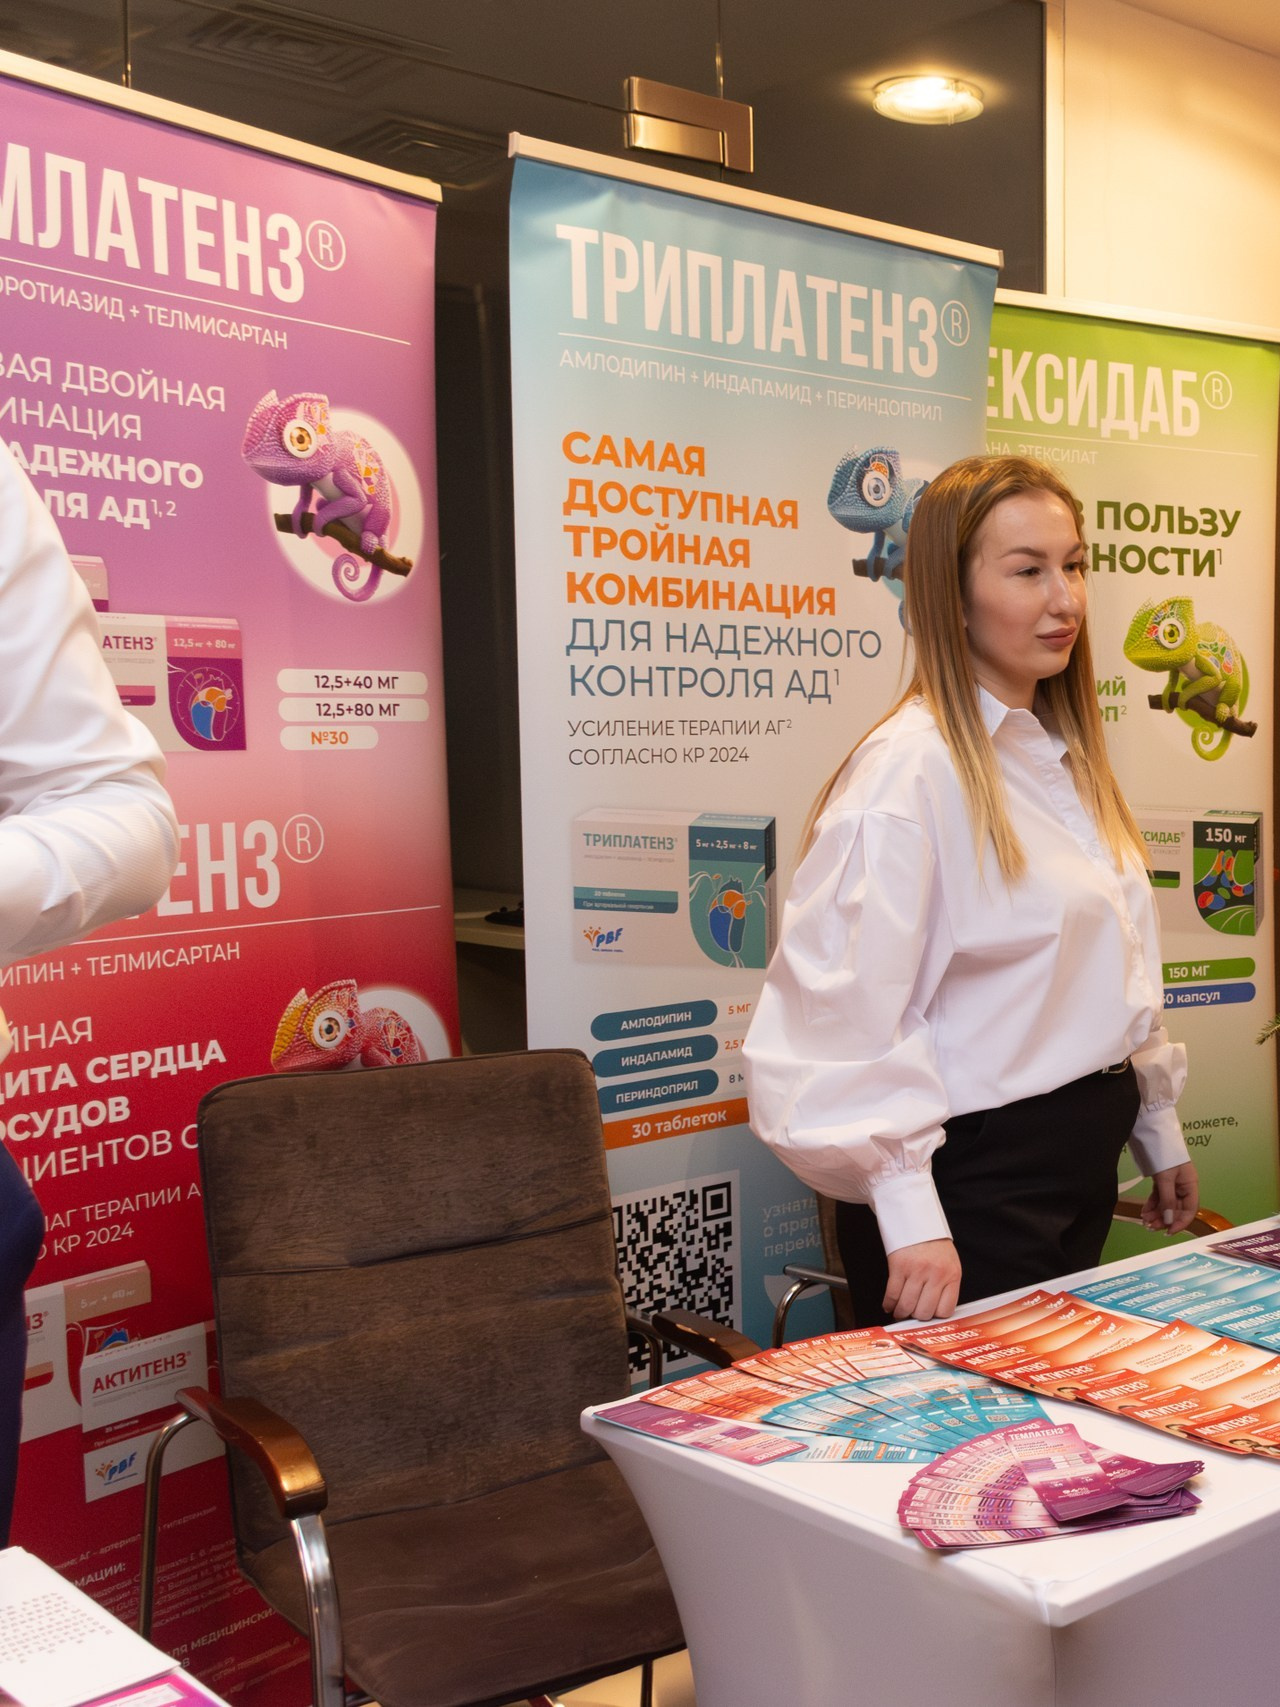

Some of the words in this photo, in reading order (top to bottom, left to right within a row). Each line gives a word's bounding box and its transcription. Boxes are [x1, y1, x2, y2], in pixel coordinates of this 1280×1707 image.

[0, 275, 125, 322] РОТИАЗИД
[129, 305, 140, 317] +
[147, 304, 288, 351] ТЕЛМИСАРТАН
[0, 352, 52, 385] АЯ
[62, 362, 225, 412] ДВОЙНАЯ
[559, 348, 686, 384] АМЛОДИПИН
[690, 372, 699, 383] +
[703, 369, 812, 406] ИНДАПАМИД
[826, 389, 942, 422] ПЕРИНДОПРИЛ
[561, 431, 706, 477] САМАЯ
[1018, 443, 1098, 465] ЭТЕКСИЛАТ
[562, 478, 799, 530] ДОСТУПНАЯ
[1097, 500, 1241, 538] ПОЛЬЗУ
[562, 522, 750, 568] ТРОЙНАЯ
[566, 571, 836, 619] КОМБИНАЦИЯ
[174, 638, 194, 650] 12,5
[566, 618, 652, 657] ДЛЯ
[666, 622, 882, 660] НАДЕЖНОГО
[314, 674, 372, 692] 12,5+40
[378, 676, 399, 690] МГ
[569, 665, 773, 699] КОНТРОЛЯ
[315, 703, 374, 719] 12,5+80
[379, 704, 400, 717] МГ
[311, 730, 349, 746] №30
[567, 720, 675, 737] УСИЛЕНИЕ
[678, 719, 761, 736] ТЕРАПИИ
[568, 748, 678, 766] СОГЛАСНО
[683, 747, 705, 763] КР
[709, 746, 750, 762] 2024
[583, 833, 675, 851] ТРИПЛАТЕНЗ
[1140, 831, 1180, 844] СИДАБ
[1205, 828, 1232, 843] 150
[1235, 834, 1247, 844] мг
[595, 927, 624, 948] PBF
[87, 942, 241, 977] ТЕЛМИСАРТАН
[1169, 966, 1188, 979] 150
[1192, 965, 1210, 978] МГ
[1177, 991, 1220, 1005] капсул
[620, 1011, 692, 1031] АМЛОДИПИН
[728, 1005, 734, 1015] 5
[621, 1046, 693, 1067] ИНДАПАМИД
[0, 1062, 78, 1105] ИТА
[86, 1039, 227, 1084] СЕРДЦА
[616, 1080, 699, 1104] ПЕРИНДОПРИЛ
[729, 1074, 736, 1083] 8
[632, 1122, 651, 1139] 30
[655, 1110, 727, 1134] таблеток
[1182, 1116, 1239, 1131] можете,
[1185, 1133, 1212, 1147] оду
[82, 1186, 181, 1222] ТЕРАПИИ
[53, 1234, 81, 1256] КР
[86, 1222, 135, 1248] 2024
[92, 1351, 188, 1394] АКТИТЕНЗ
